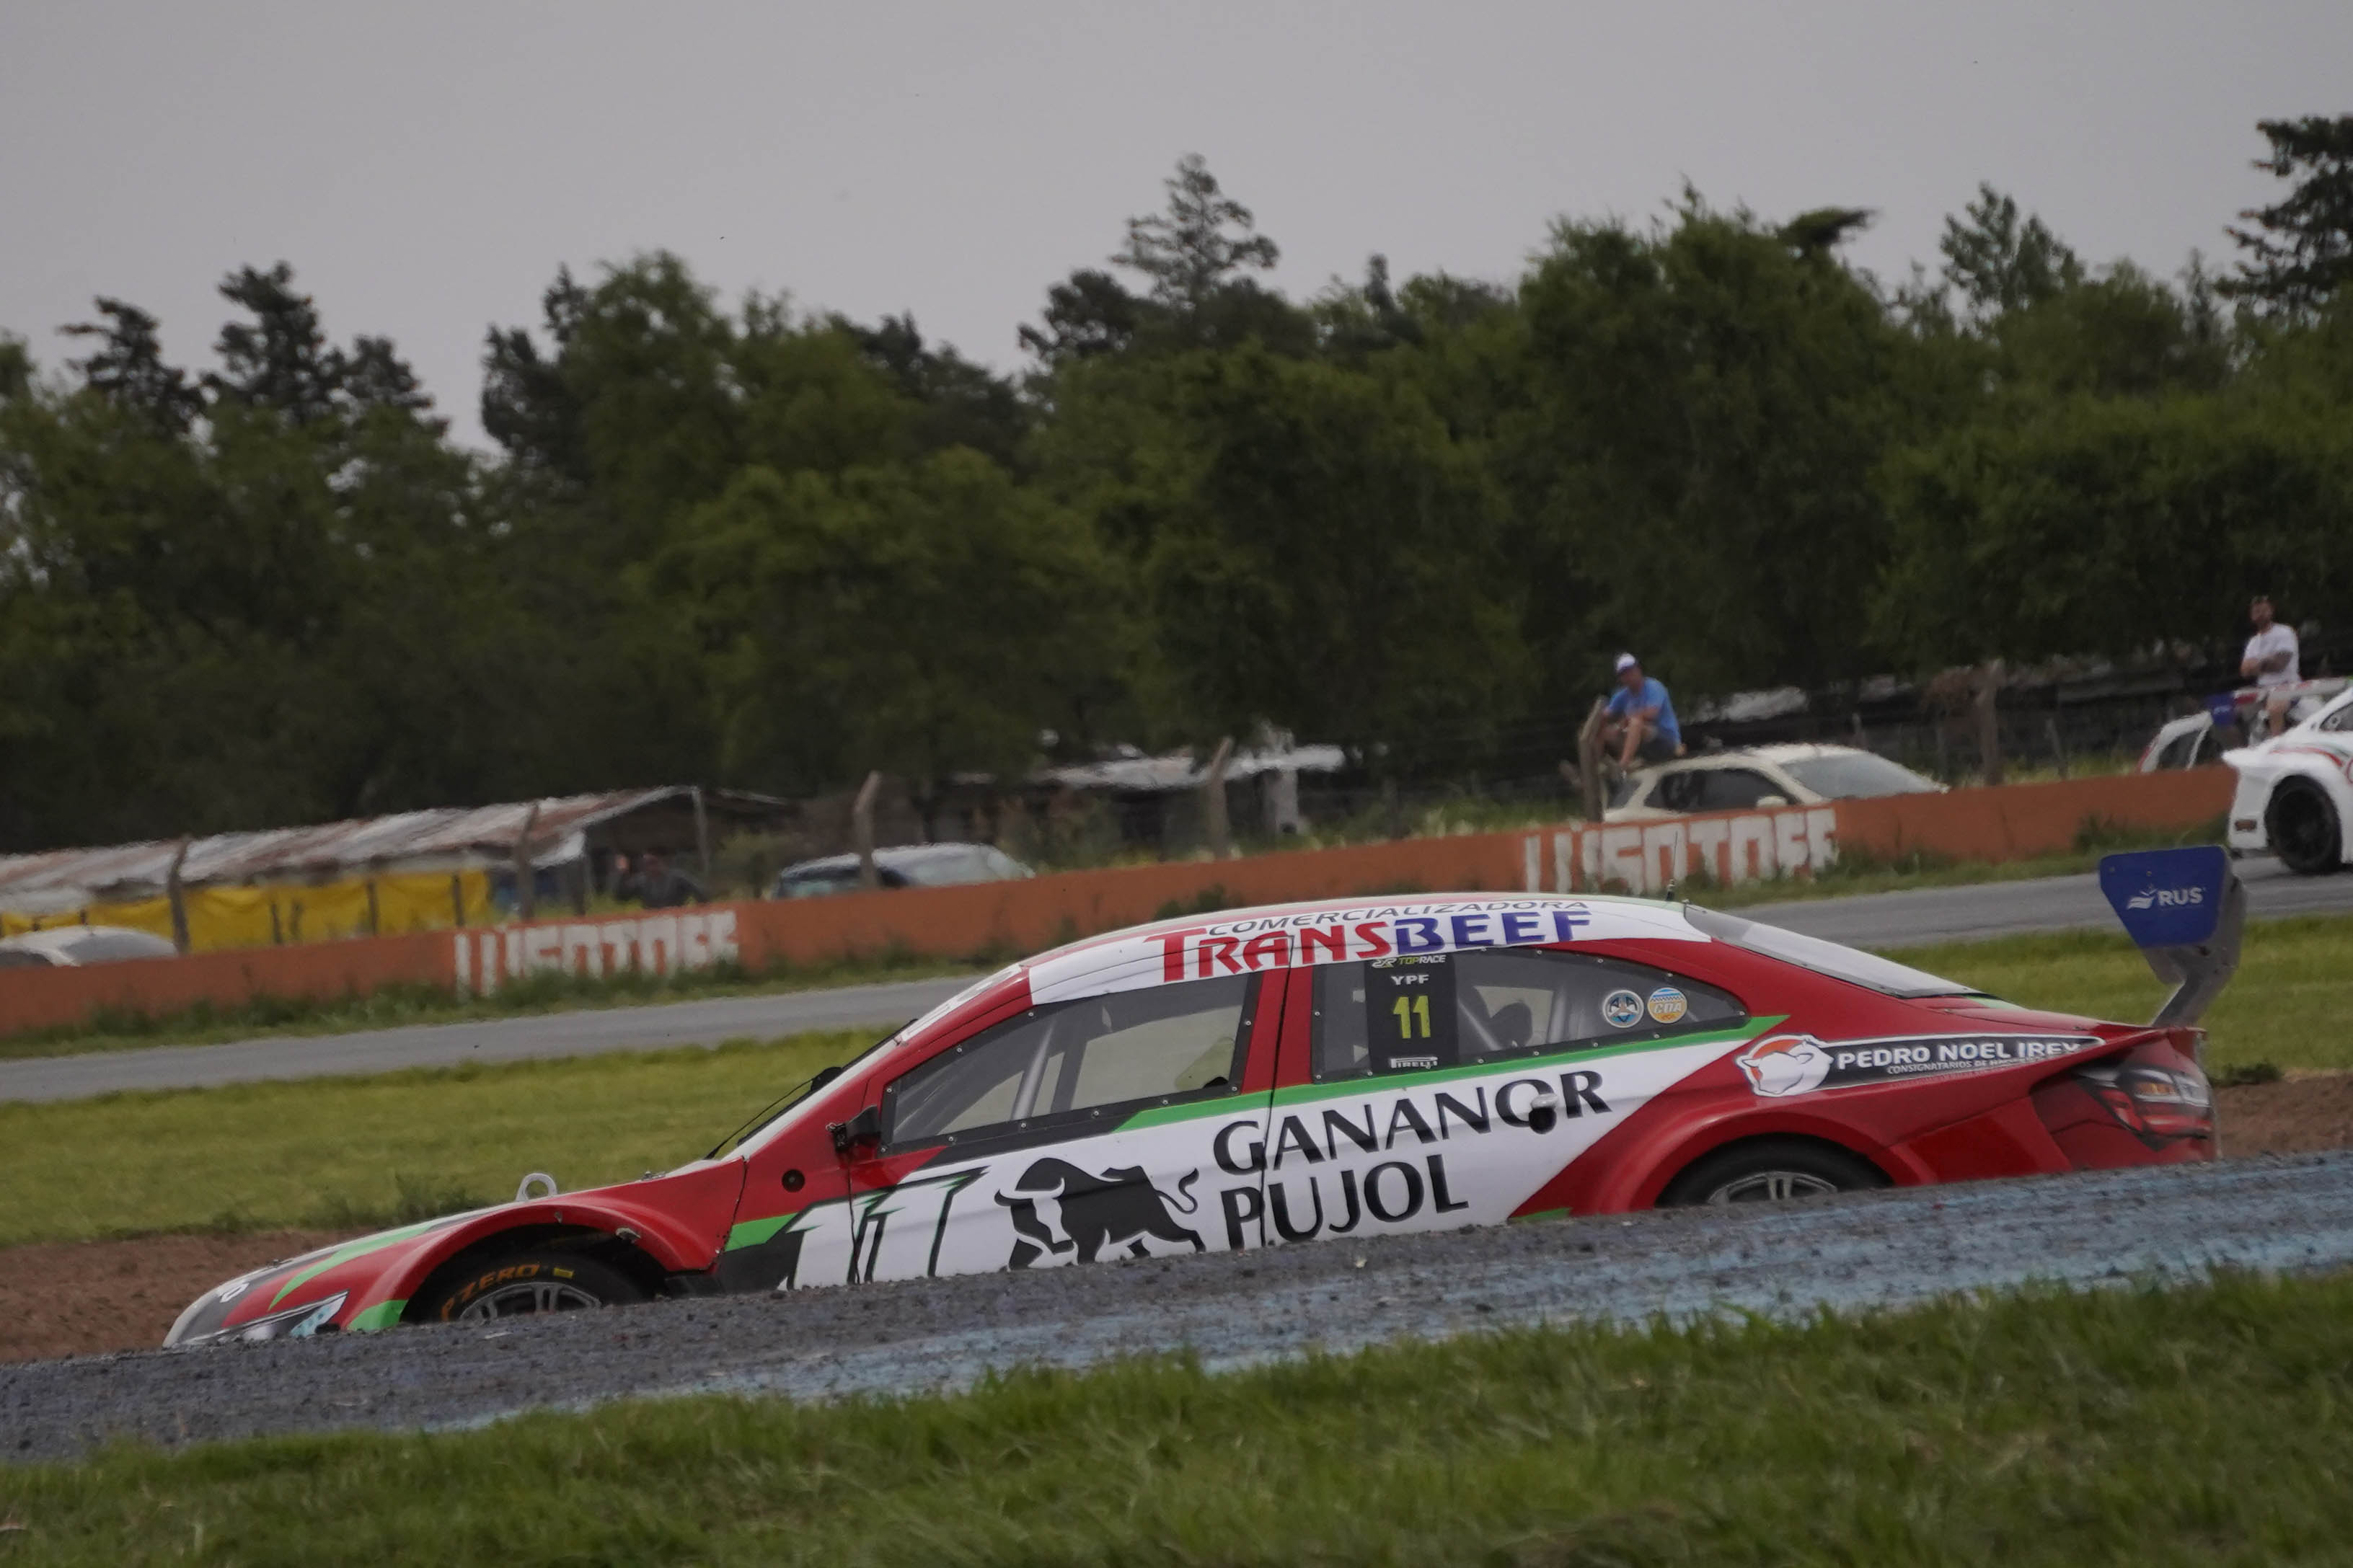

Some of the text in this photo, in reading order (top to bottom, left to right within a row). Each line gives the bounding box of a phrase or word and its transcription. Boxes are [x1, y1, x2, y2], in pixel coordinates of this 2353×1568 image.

[2158, 887, 2203, 906] RUS
[1209, 901, 1589, 936] COMERCIALIZADORA
[1144, 910, 1592, 983] TRANSBEEF
[1391, 974, 1429, 985] YPF
[1392, 995, 1431, 1039] 11
[1839, 1046, 1932, 1071] PEDRO
[1938, 1042, 2012, 1062] NOEL
[1886, 1060, 1972, 1075] CONSIGNATARIOS
[1213, 1070, 1612, 1176] GANANOR
[1220, 1154, 1469, 1250] PUJOL
